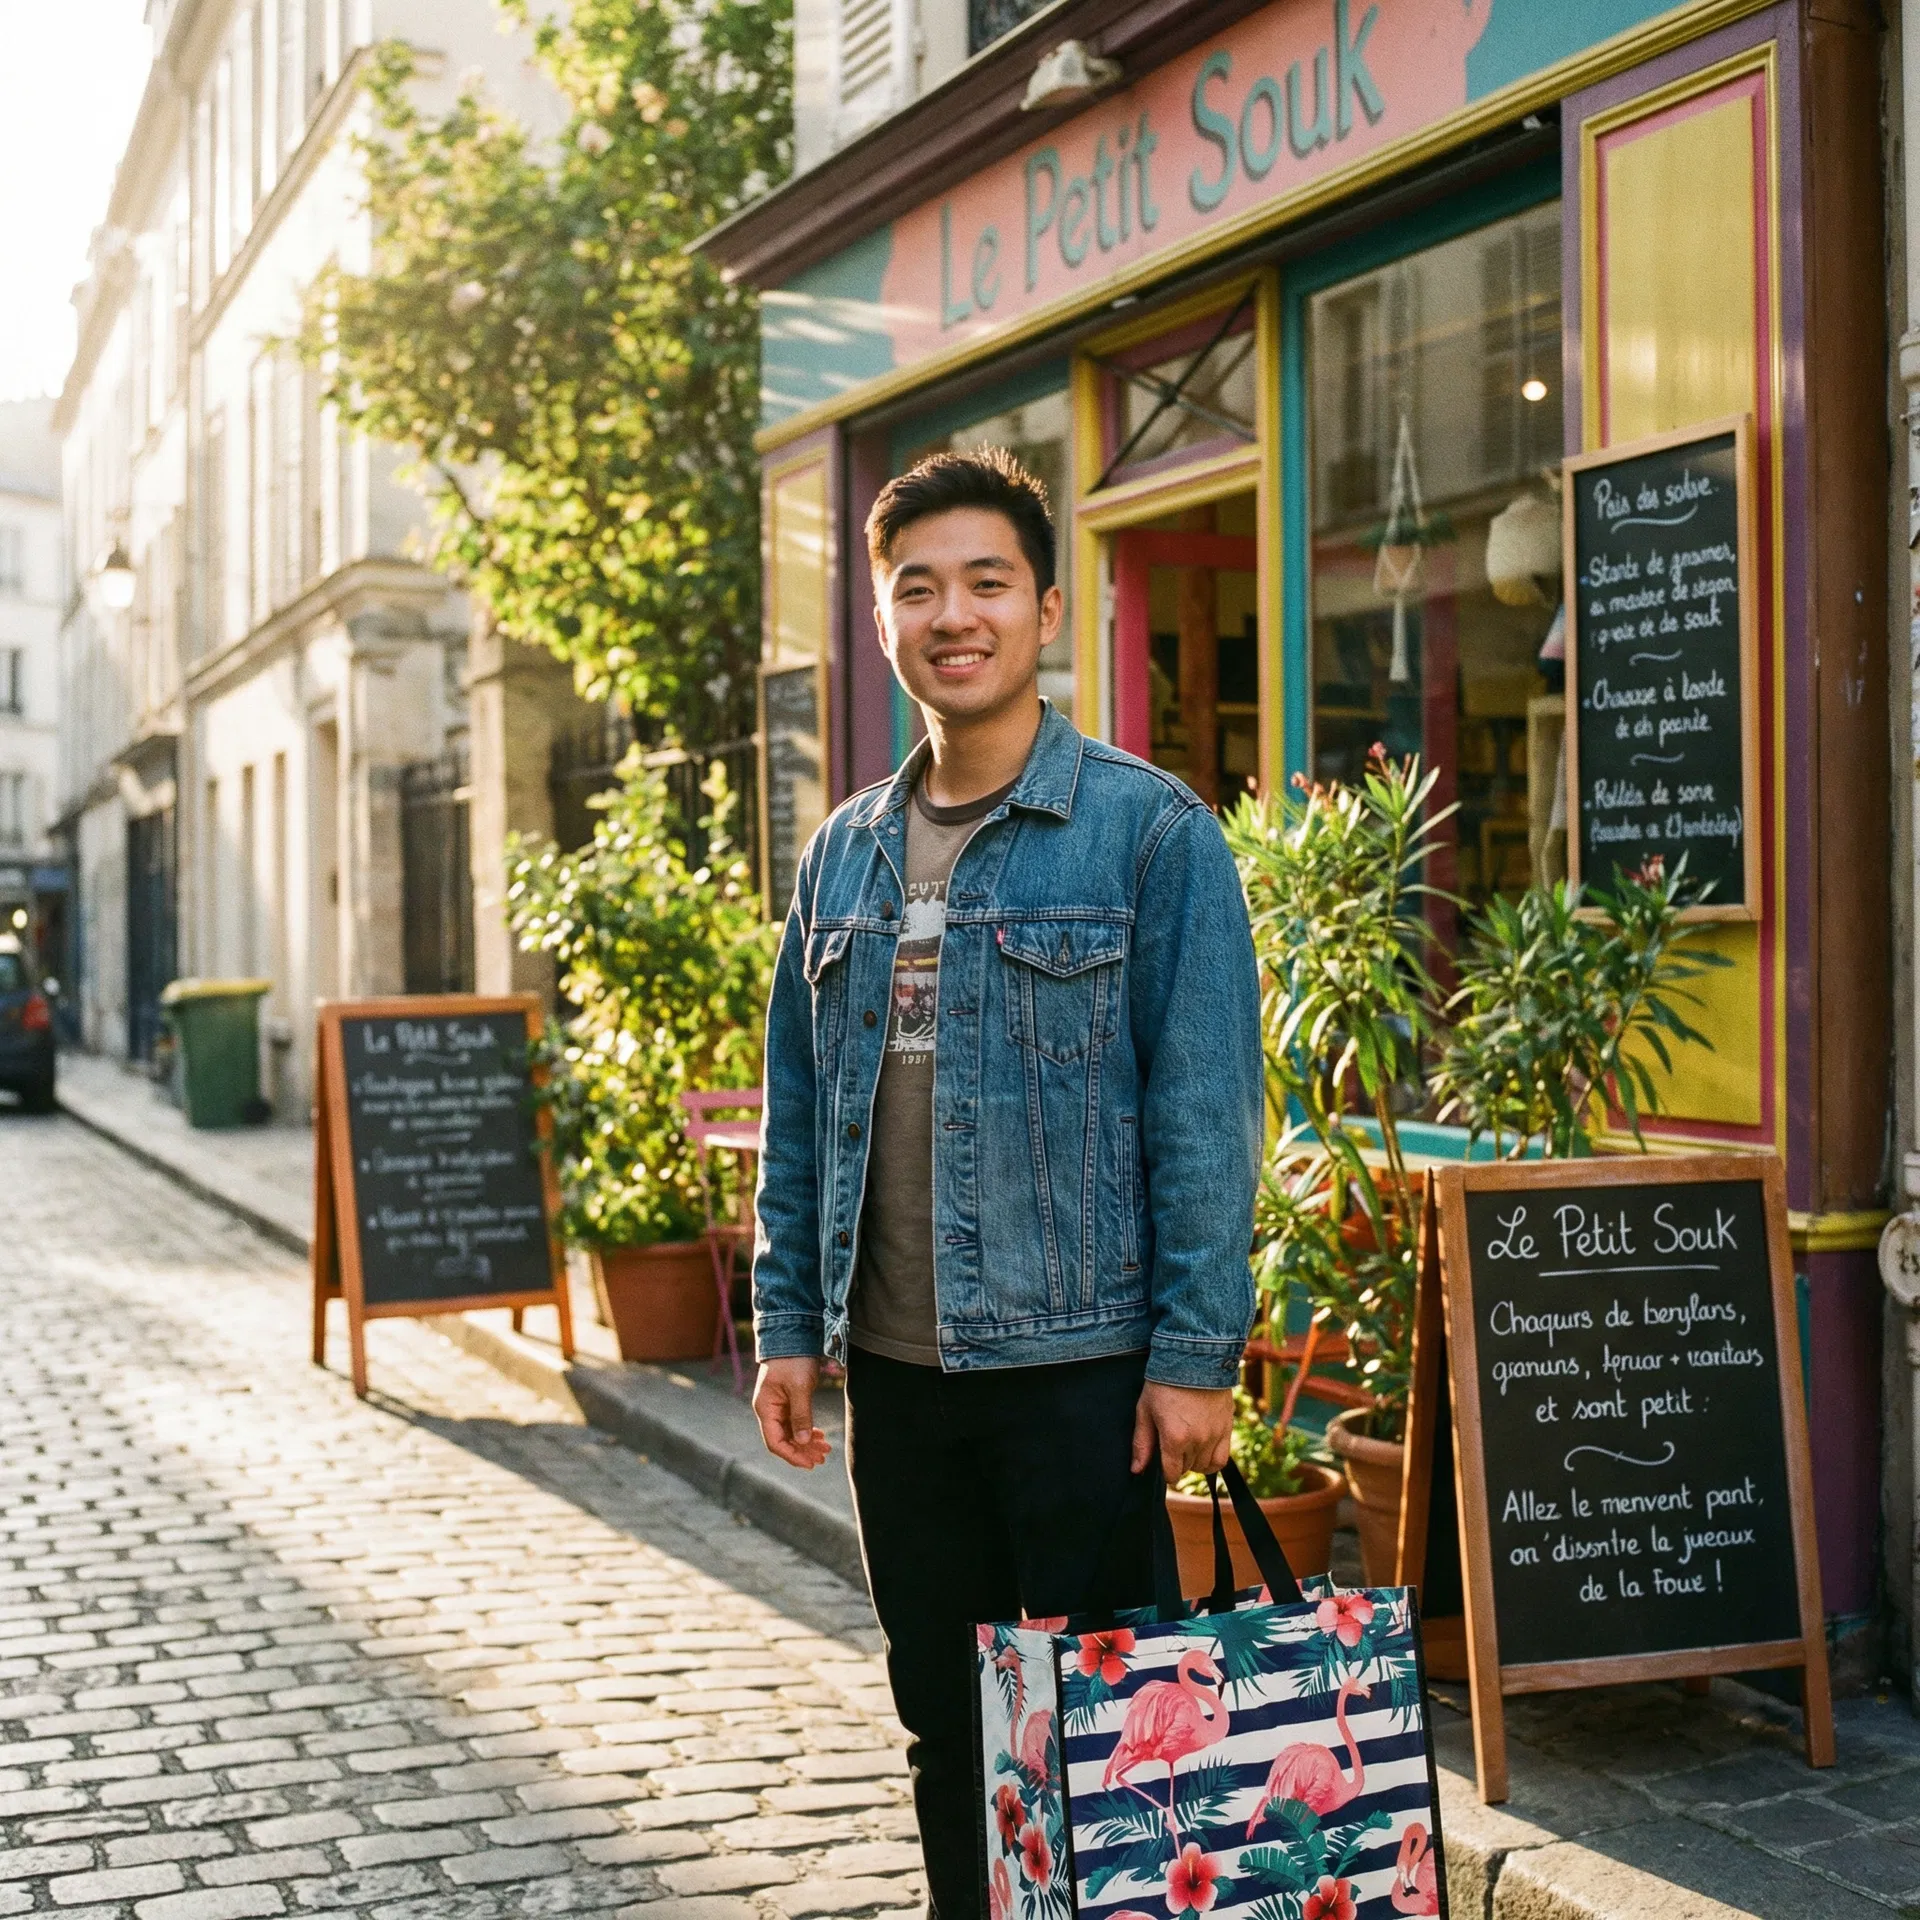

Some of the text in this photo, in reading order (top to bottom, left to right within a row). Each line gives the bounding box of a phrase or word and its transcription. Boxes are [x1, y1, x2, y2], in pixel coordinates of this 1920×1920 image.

[940, 0, 1387, 331] Le Petit Souk
[1487, 1202, 1739, 1260] Le Petit Souk
[1604, 1298, 1635, 1329] de
[1535, 1395, 1560, 1423] et
[1571, 1388, 1629, 1420] sont
[1502, 1489, 1563, 1523] Allez
[1571, 1486, 1594, 1518] le
[1651, 1524, 1674, 1553] la
[1579, 1574, 1608, 1603] de
[1619, 1568, 1645, 1599] la
